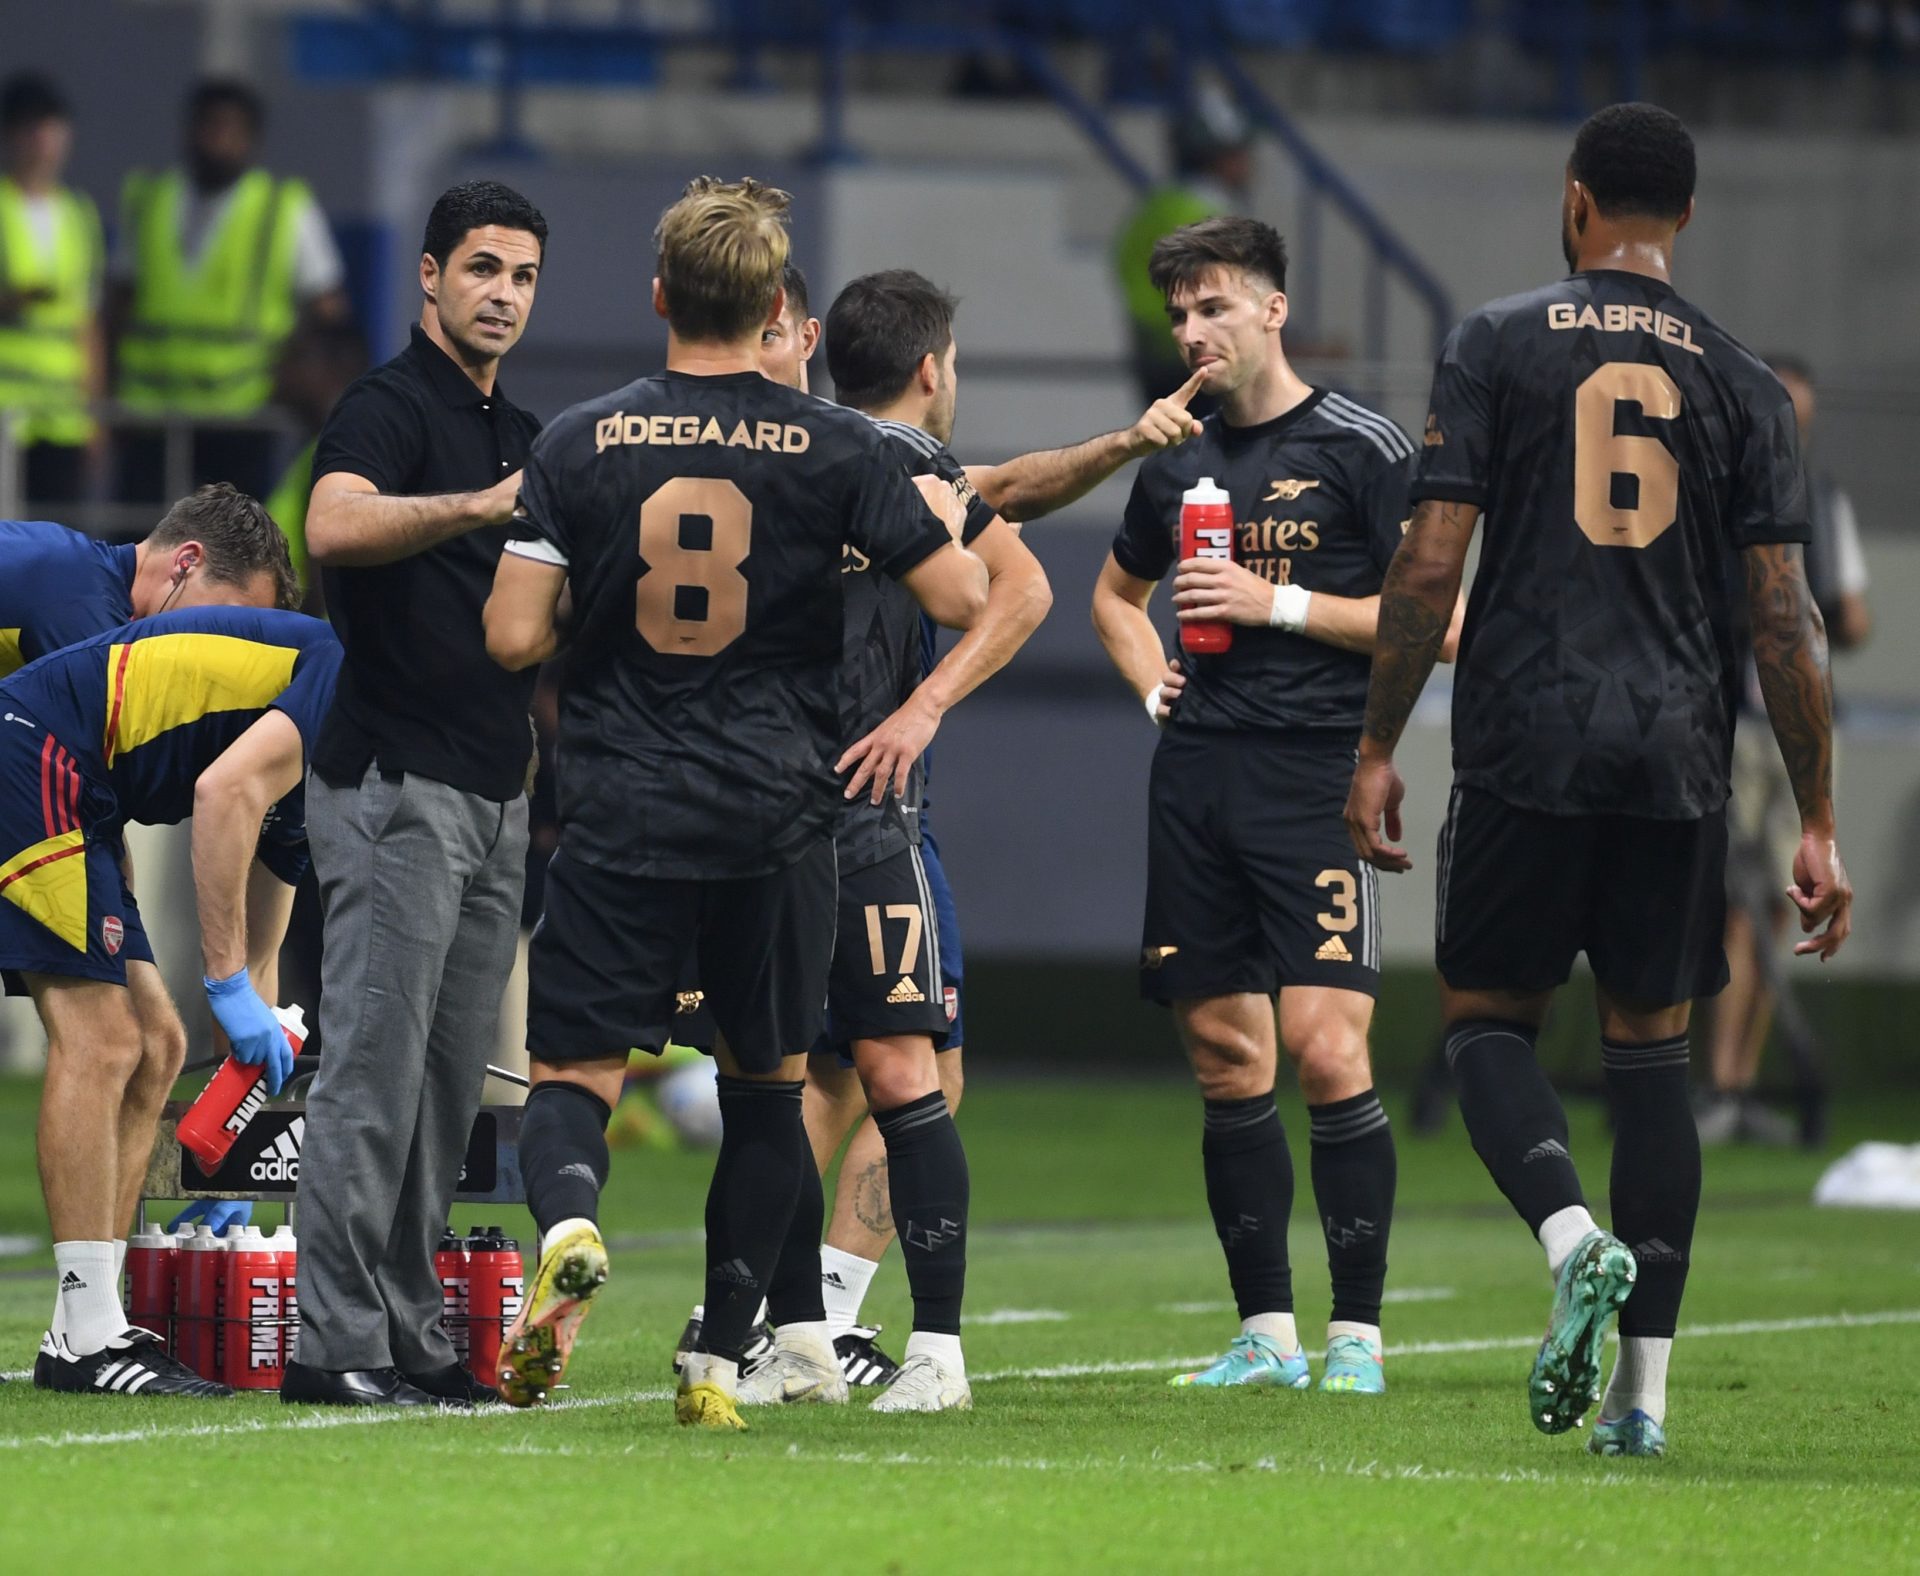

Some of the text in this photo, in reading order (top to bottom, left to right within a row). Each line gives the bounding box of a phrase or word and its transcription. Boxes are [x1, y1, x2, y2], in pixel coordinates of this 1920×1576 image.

[1548, 303, 1704, 355] GABRIEL
[595, 411, 810, 454] ØDEGAARD
[1574, 361, 1681, 548] 6
[635, 476, 753, 657] 8
[1315, 869, 1358, 932] 3
[864, 904, 923, 975] 17
[886, 992, 926, 1004] adidas
[251, 1277, 280, 1368] PRIME
